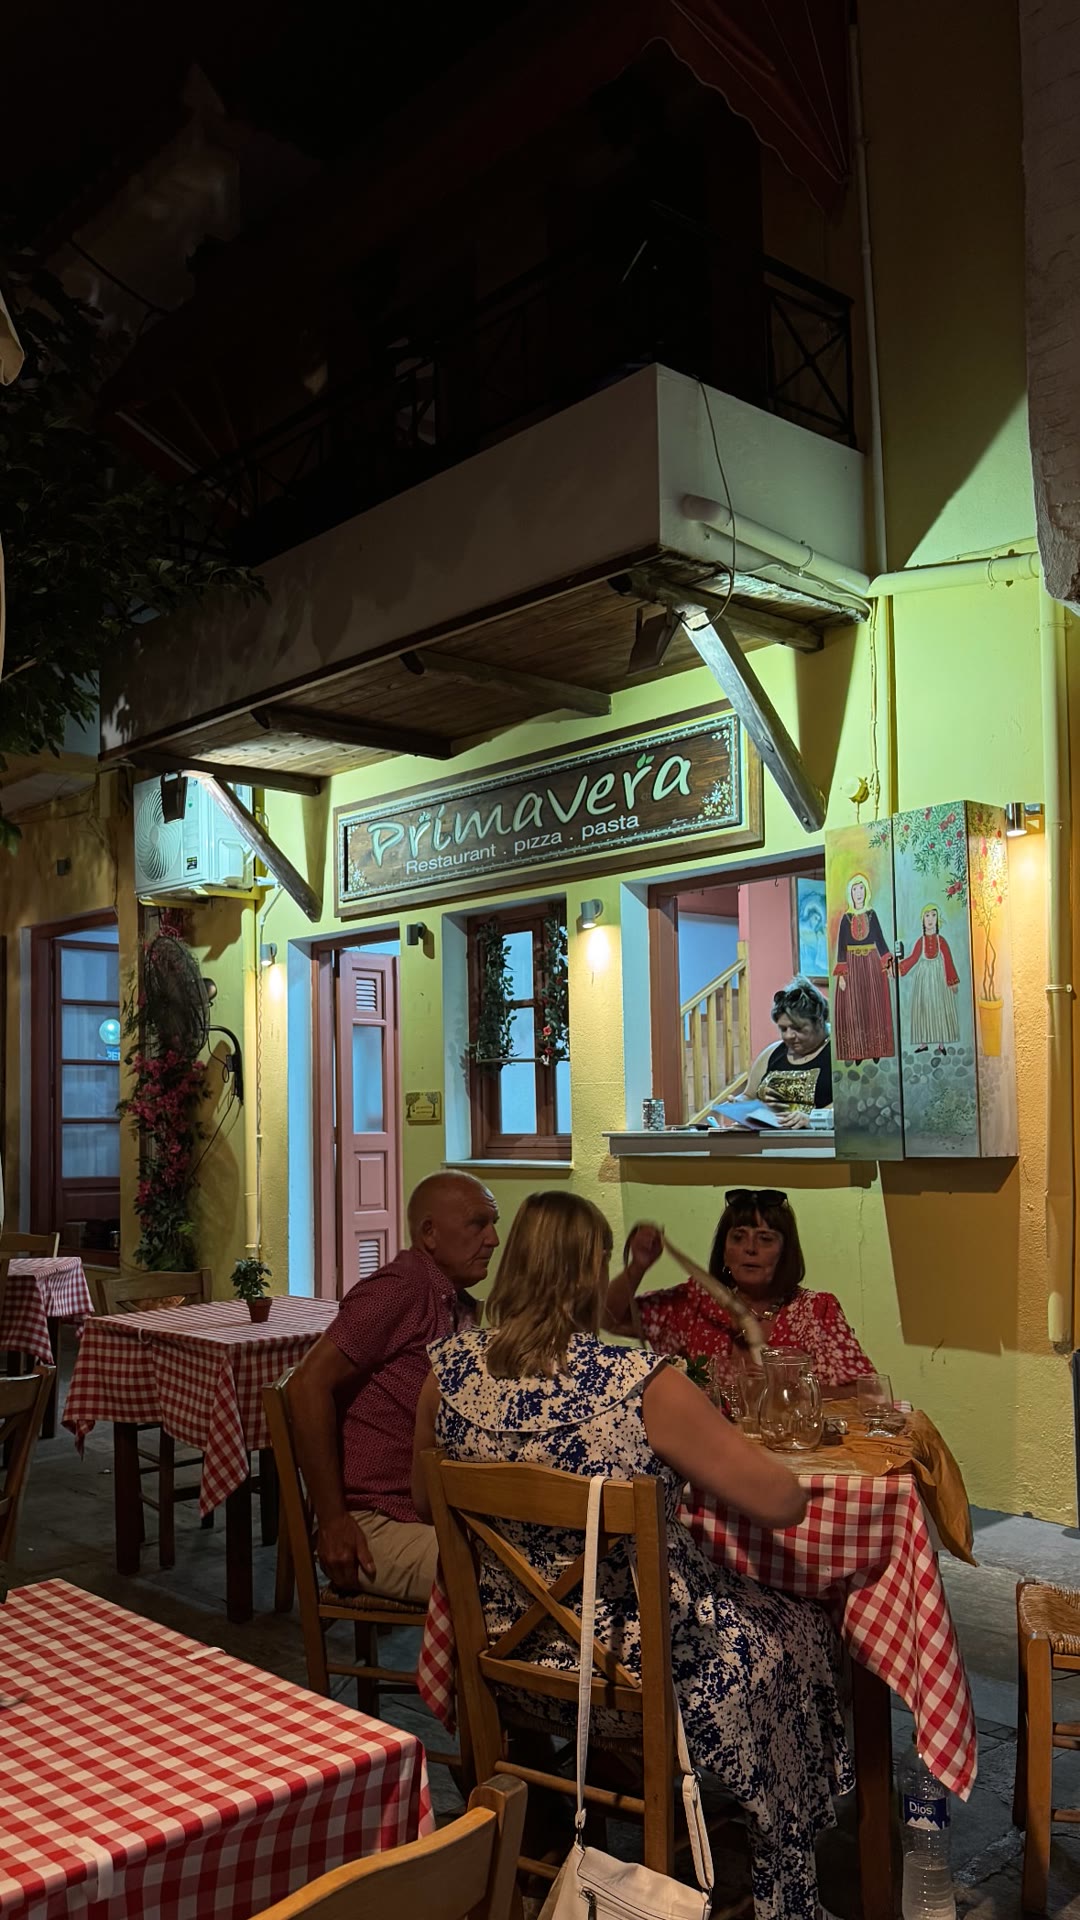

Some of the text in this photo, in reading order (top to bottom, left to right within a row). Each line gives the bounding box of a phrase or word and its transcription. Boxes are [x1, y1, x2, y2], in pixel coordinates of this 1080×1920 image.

[367, 754, 692, 868] Primavera
[405, 815, 640, 875] Restaurant pizza pasta
[908, 1801, 933, 1816] Dios
